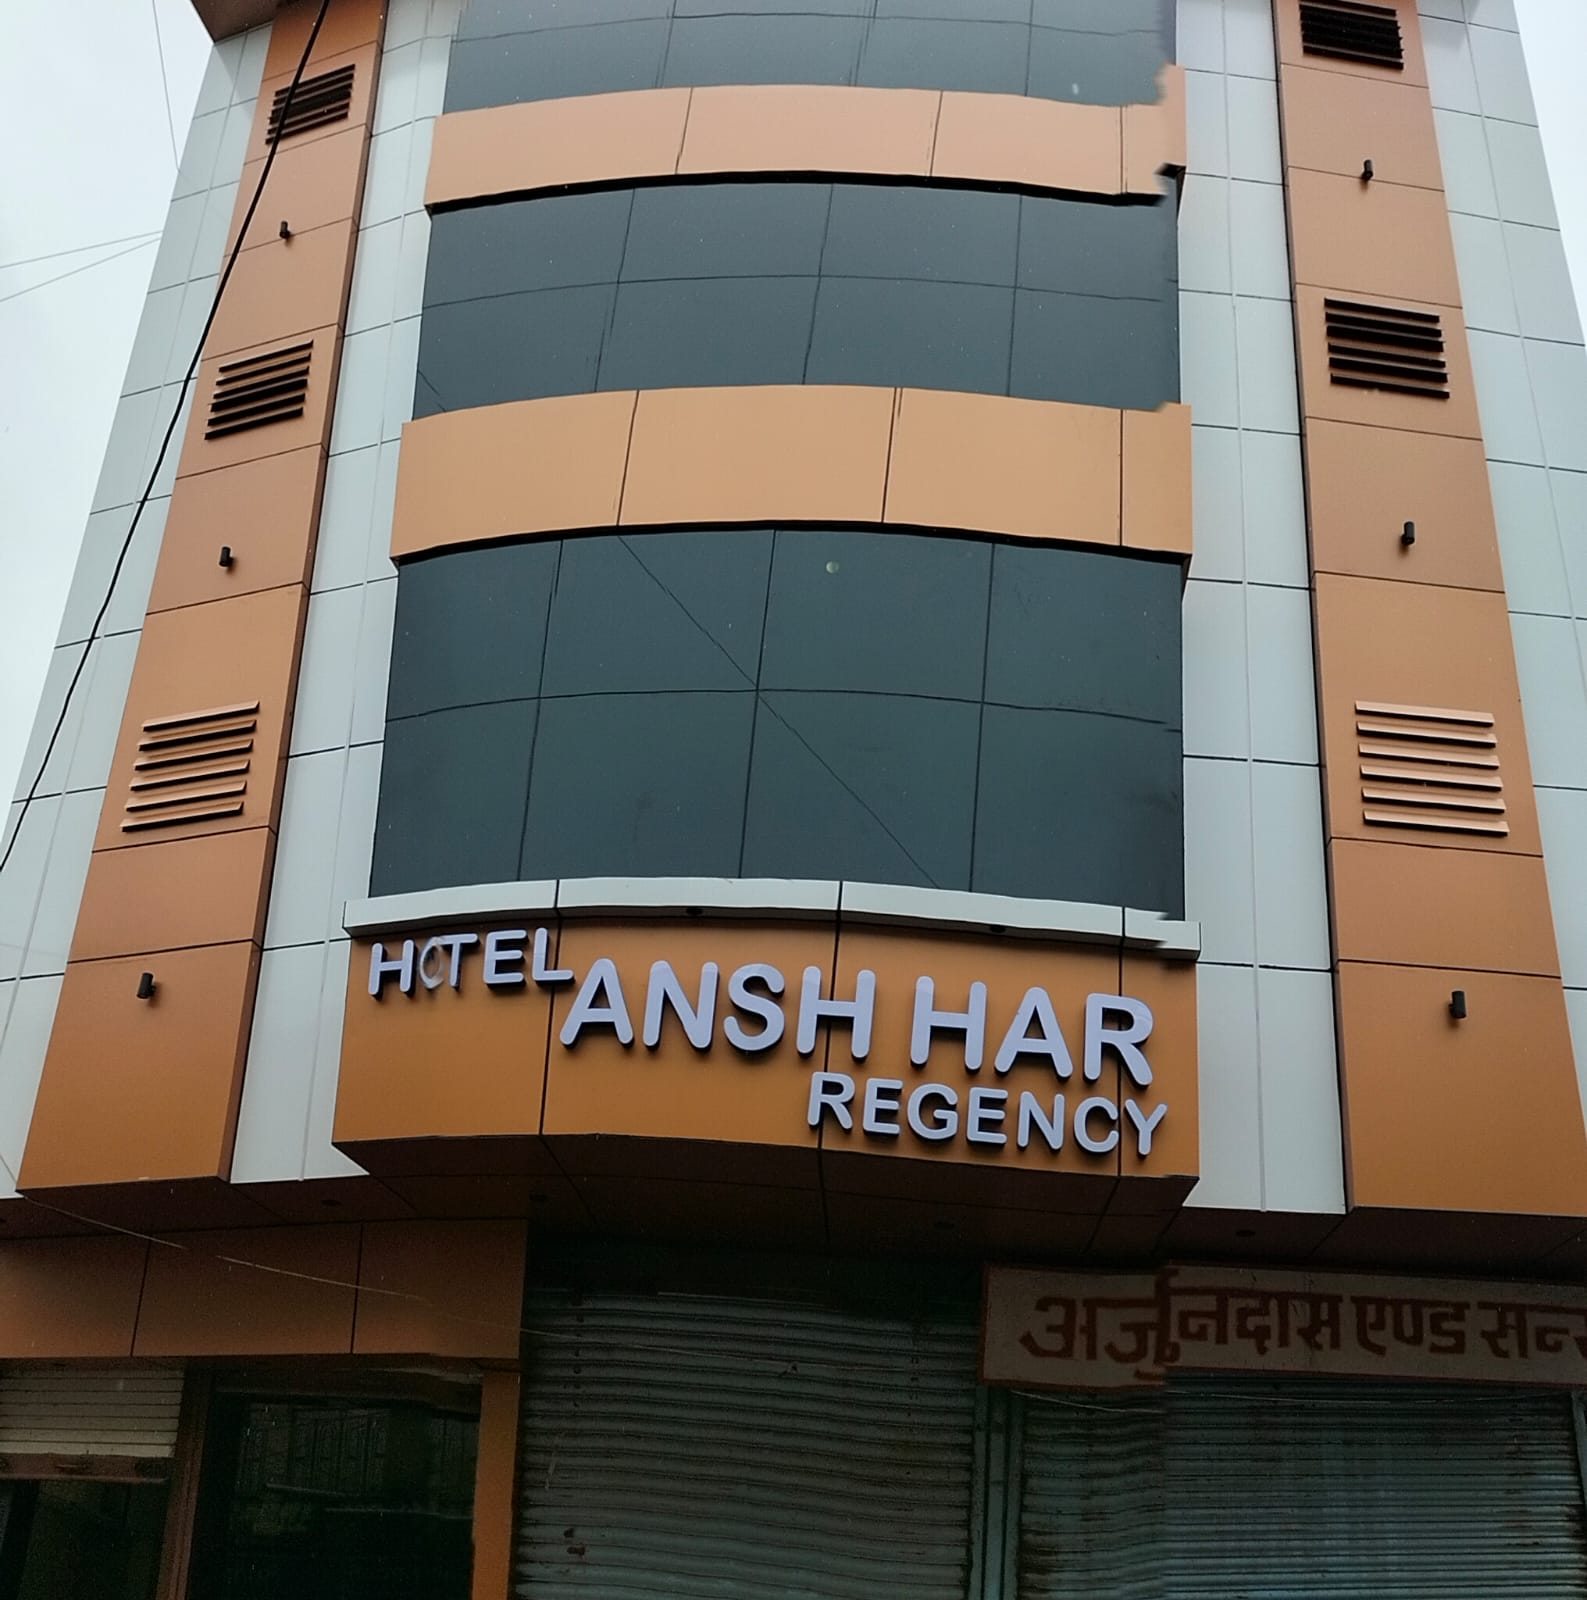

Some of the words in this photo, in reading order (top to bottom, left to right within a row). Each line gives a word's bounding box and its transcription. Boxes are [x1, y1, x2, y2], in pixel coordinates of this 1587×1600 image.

[368, 927, 574, 997] HOTEL
[559, 957, 877, 1059] ANSH
[910, 976, 1154, 1087] HAR
[807, 1071, 1168, 1157] REGENCY
[1351, 1294, 1470, 1356] एण्ड
